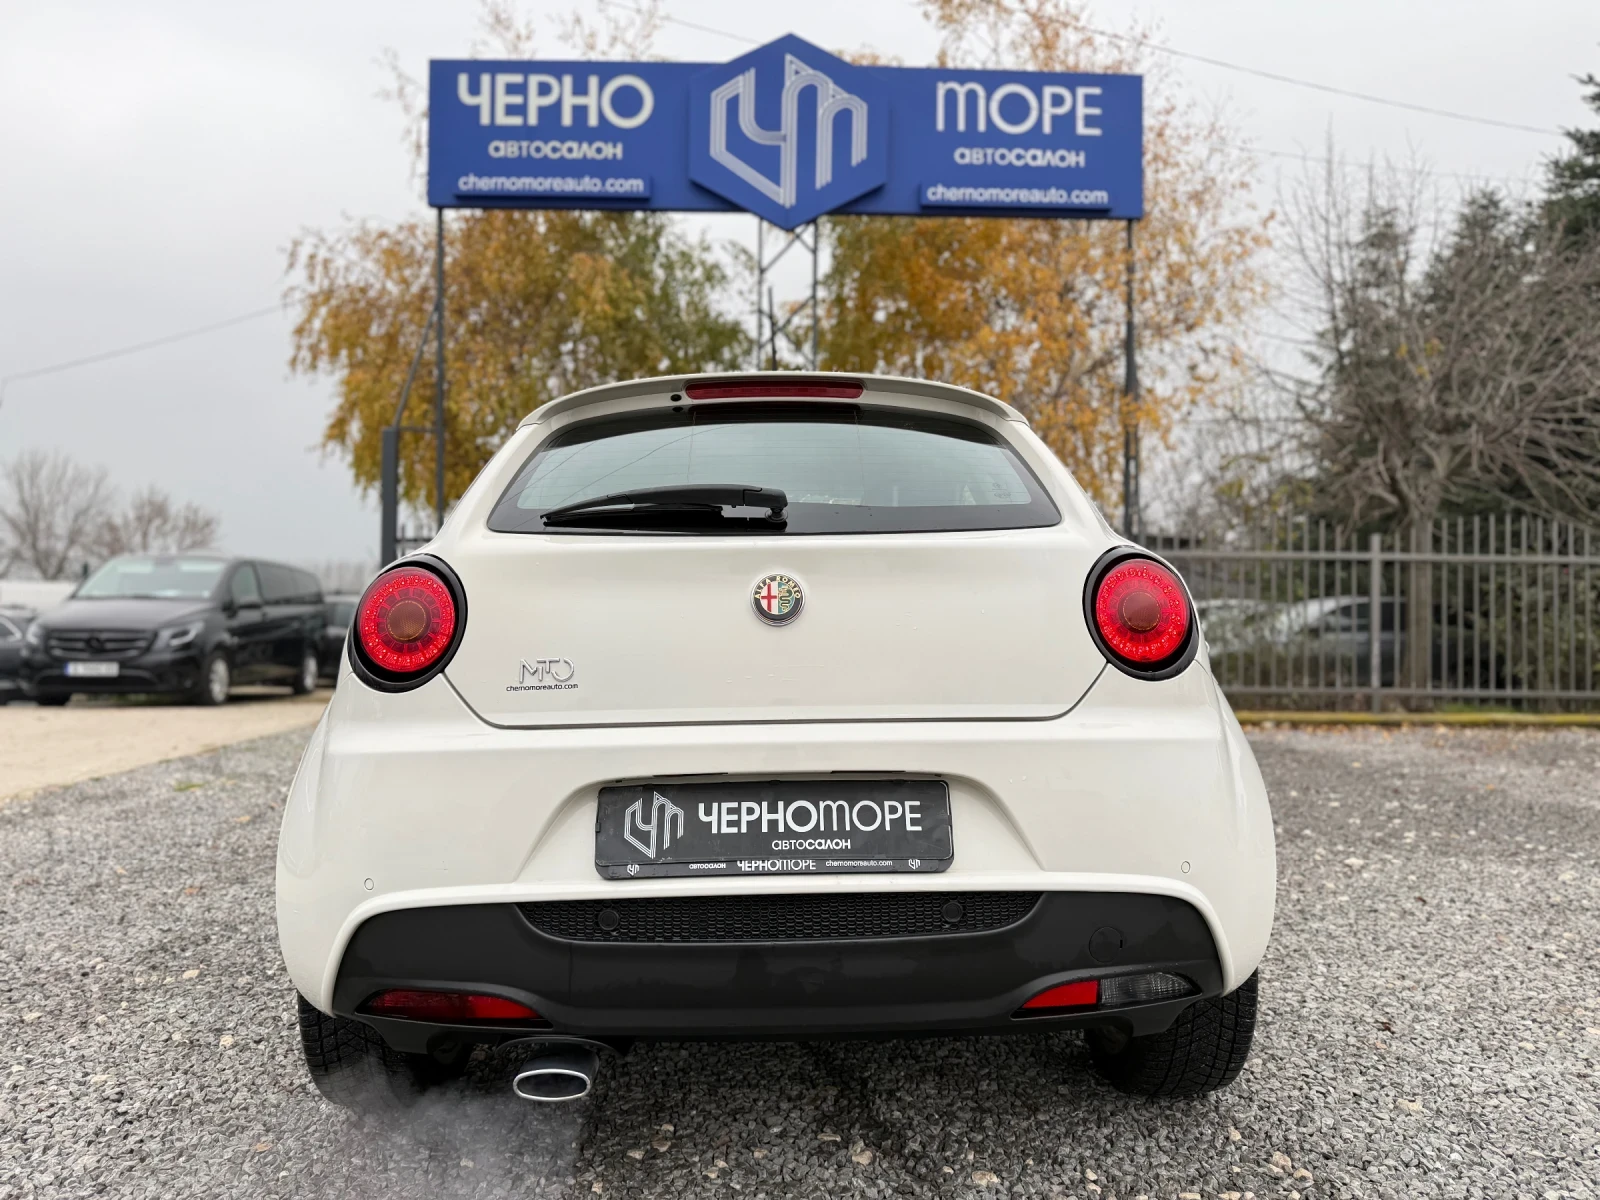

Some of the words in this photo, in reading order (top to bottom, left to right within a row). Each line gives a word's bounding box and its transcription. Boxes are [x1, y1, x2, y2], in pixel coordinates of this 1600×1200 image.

[457, 72, 655, 129] ЧЕРНО
[458, 173, 644, 193] chernomoreauto.com
[927, 183, 1108, 204] chernomoreauto.com
[776, 575, 801, 599] ROMEO
[506, 683, 579, 692] chernomoreauto.com
[825, 859, 893, 868] chernomoreauto.com
